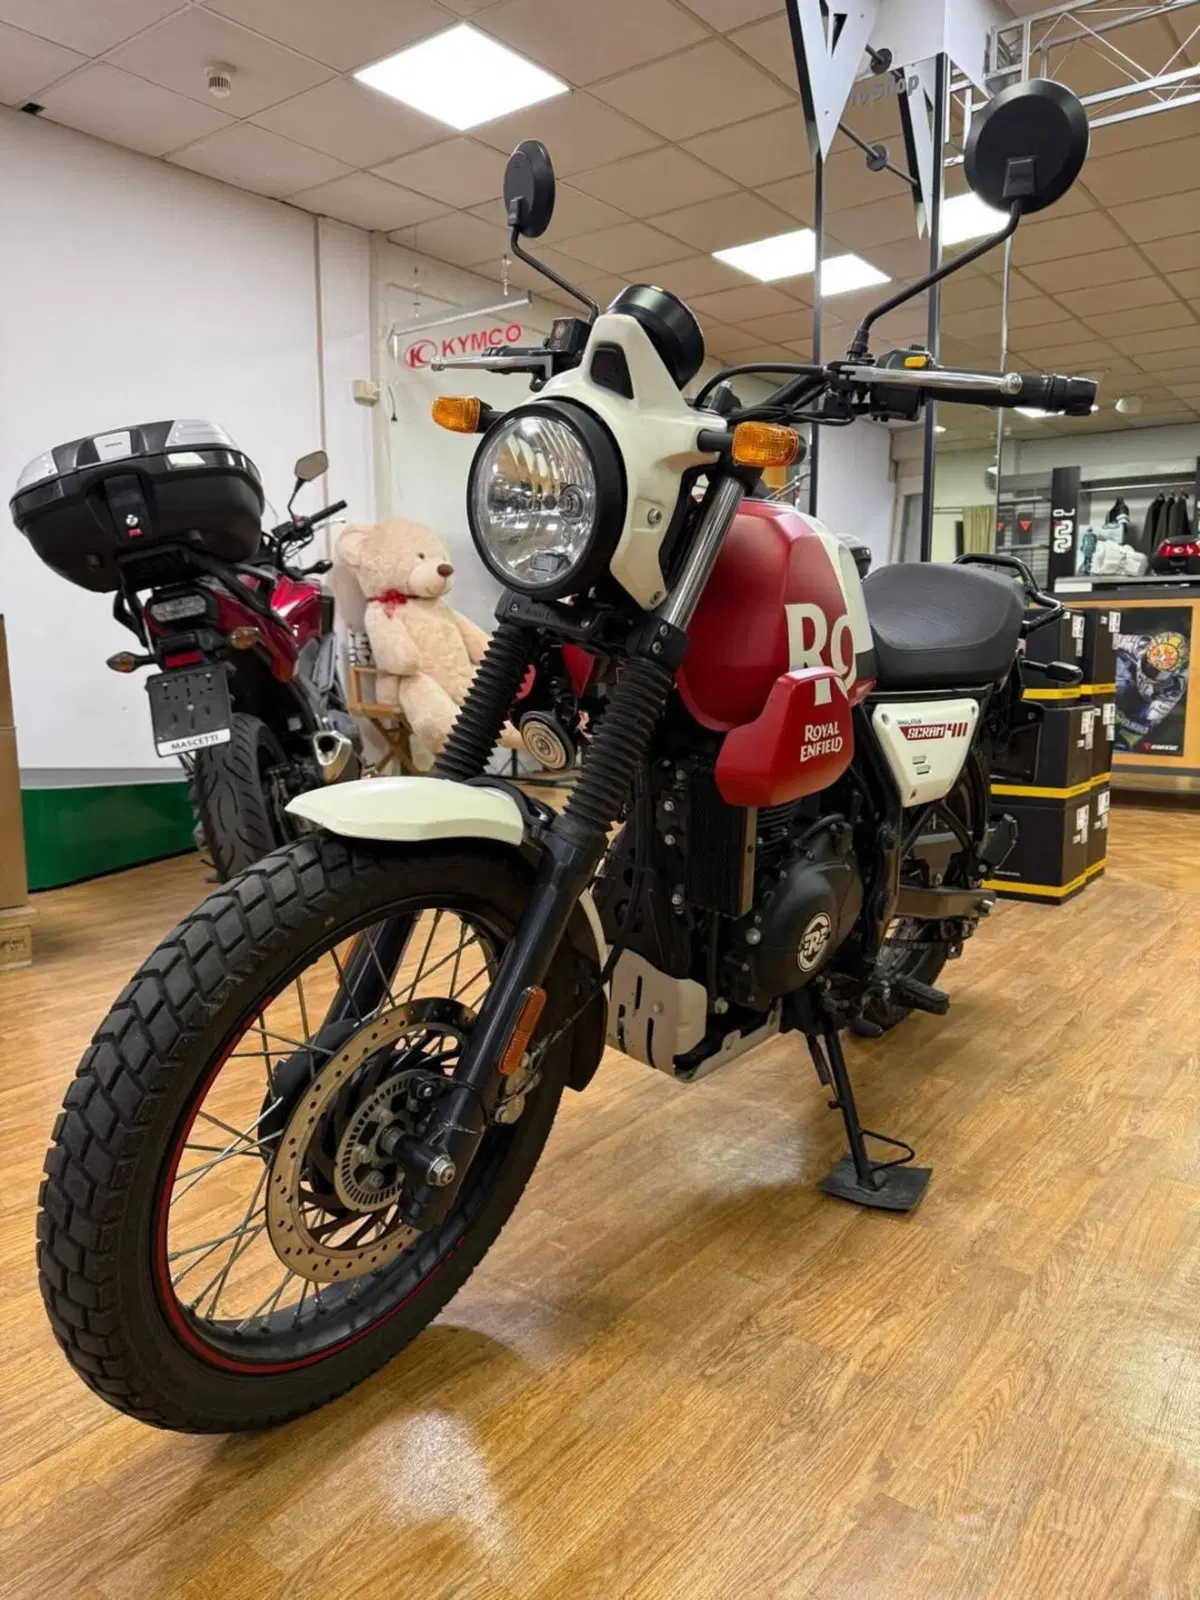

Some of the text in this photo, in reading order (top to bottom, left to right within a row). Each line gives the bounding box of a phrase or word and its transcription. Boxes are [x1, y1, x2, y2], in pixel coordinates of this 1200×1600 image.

[442, 324, 521, 357] KYMCO
[804, 721, 840, 743] ROYAL
[906, 722, 968, 739] SCRAM 411
[171, 734, 219, 750] MASCETTI
[800, 737, 843, 762] ENFIELD
